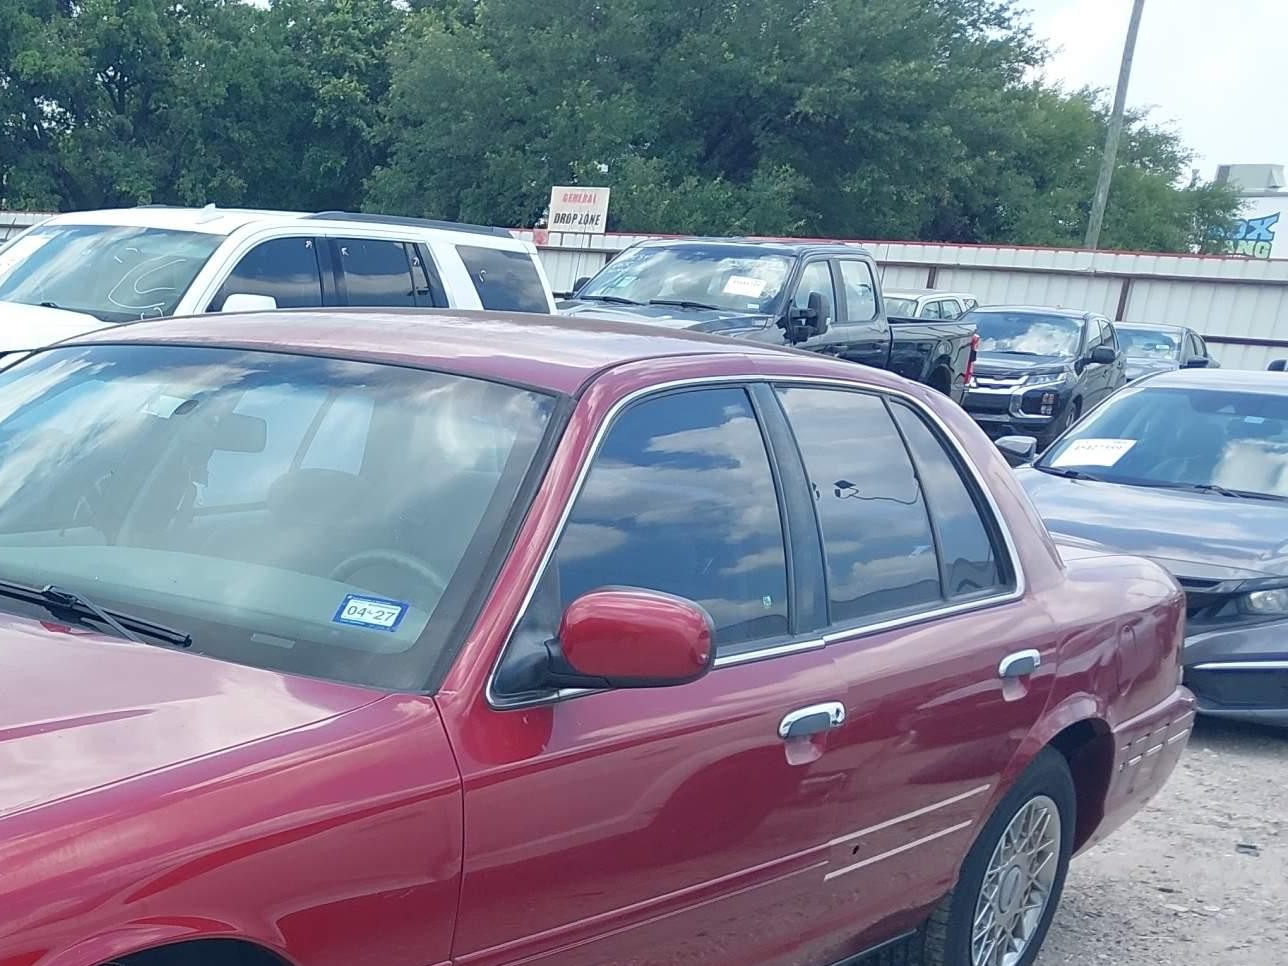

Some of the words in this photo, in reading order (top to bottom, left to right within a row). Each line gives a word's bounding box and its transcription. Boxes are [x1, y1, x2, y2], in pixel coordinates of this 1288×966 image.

[562, 193, 597, 204] GENERAL
[553, 212, 578, 225] DROP
[578, 213, 602, 226] ZONE
